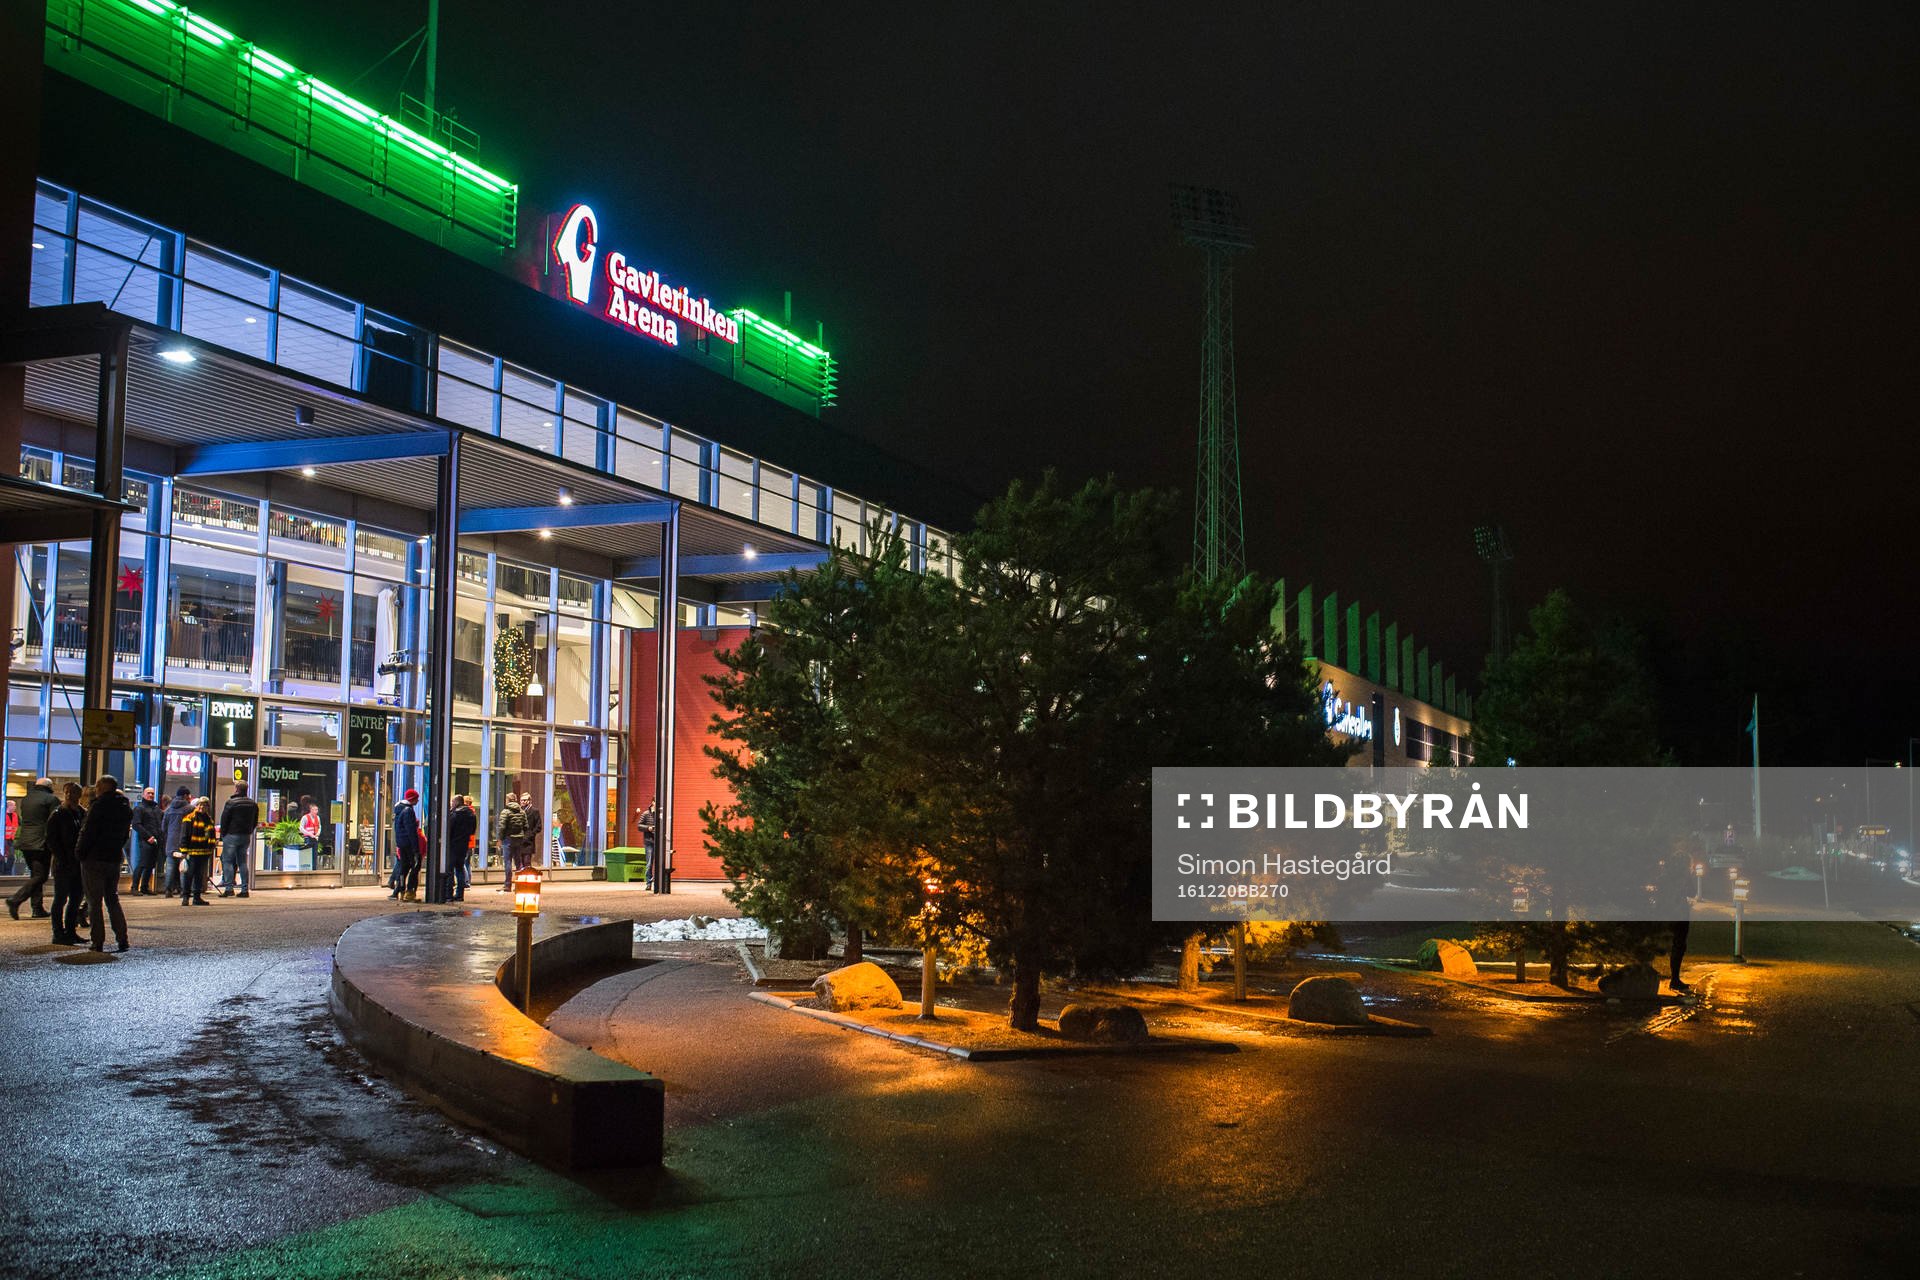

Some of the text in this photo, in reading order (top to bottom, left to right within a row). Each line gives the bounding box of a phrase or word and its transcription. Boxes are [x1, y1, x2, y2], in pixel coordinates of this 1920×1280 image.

[605, 251, 739, 344] Gavlerinken
[605, 285, 678, 346] Arena
[224, 721, 236, 747] 1
[361, 733, 372, 755] 2
[261, 766, 300, 782] Skybar
